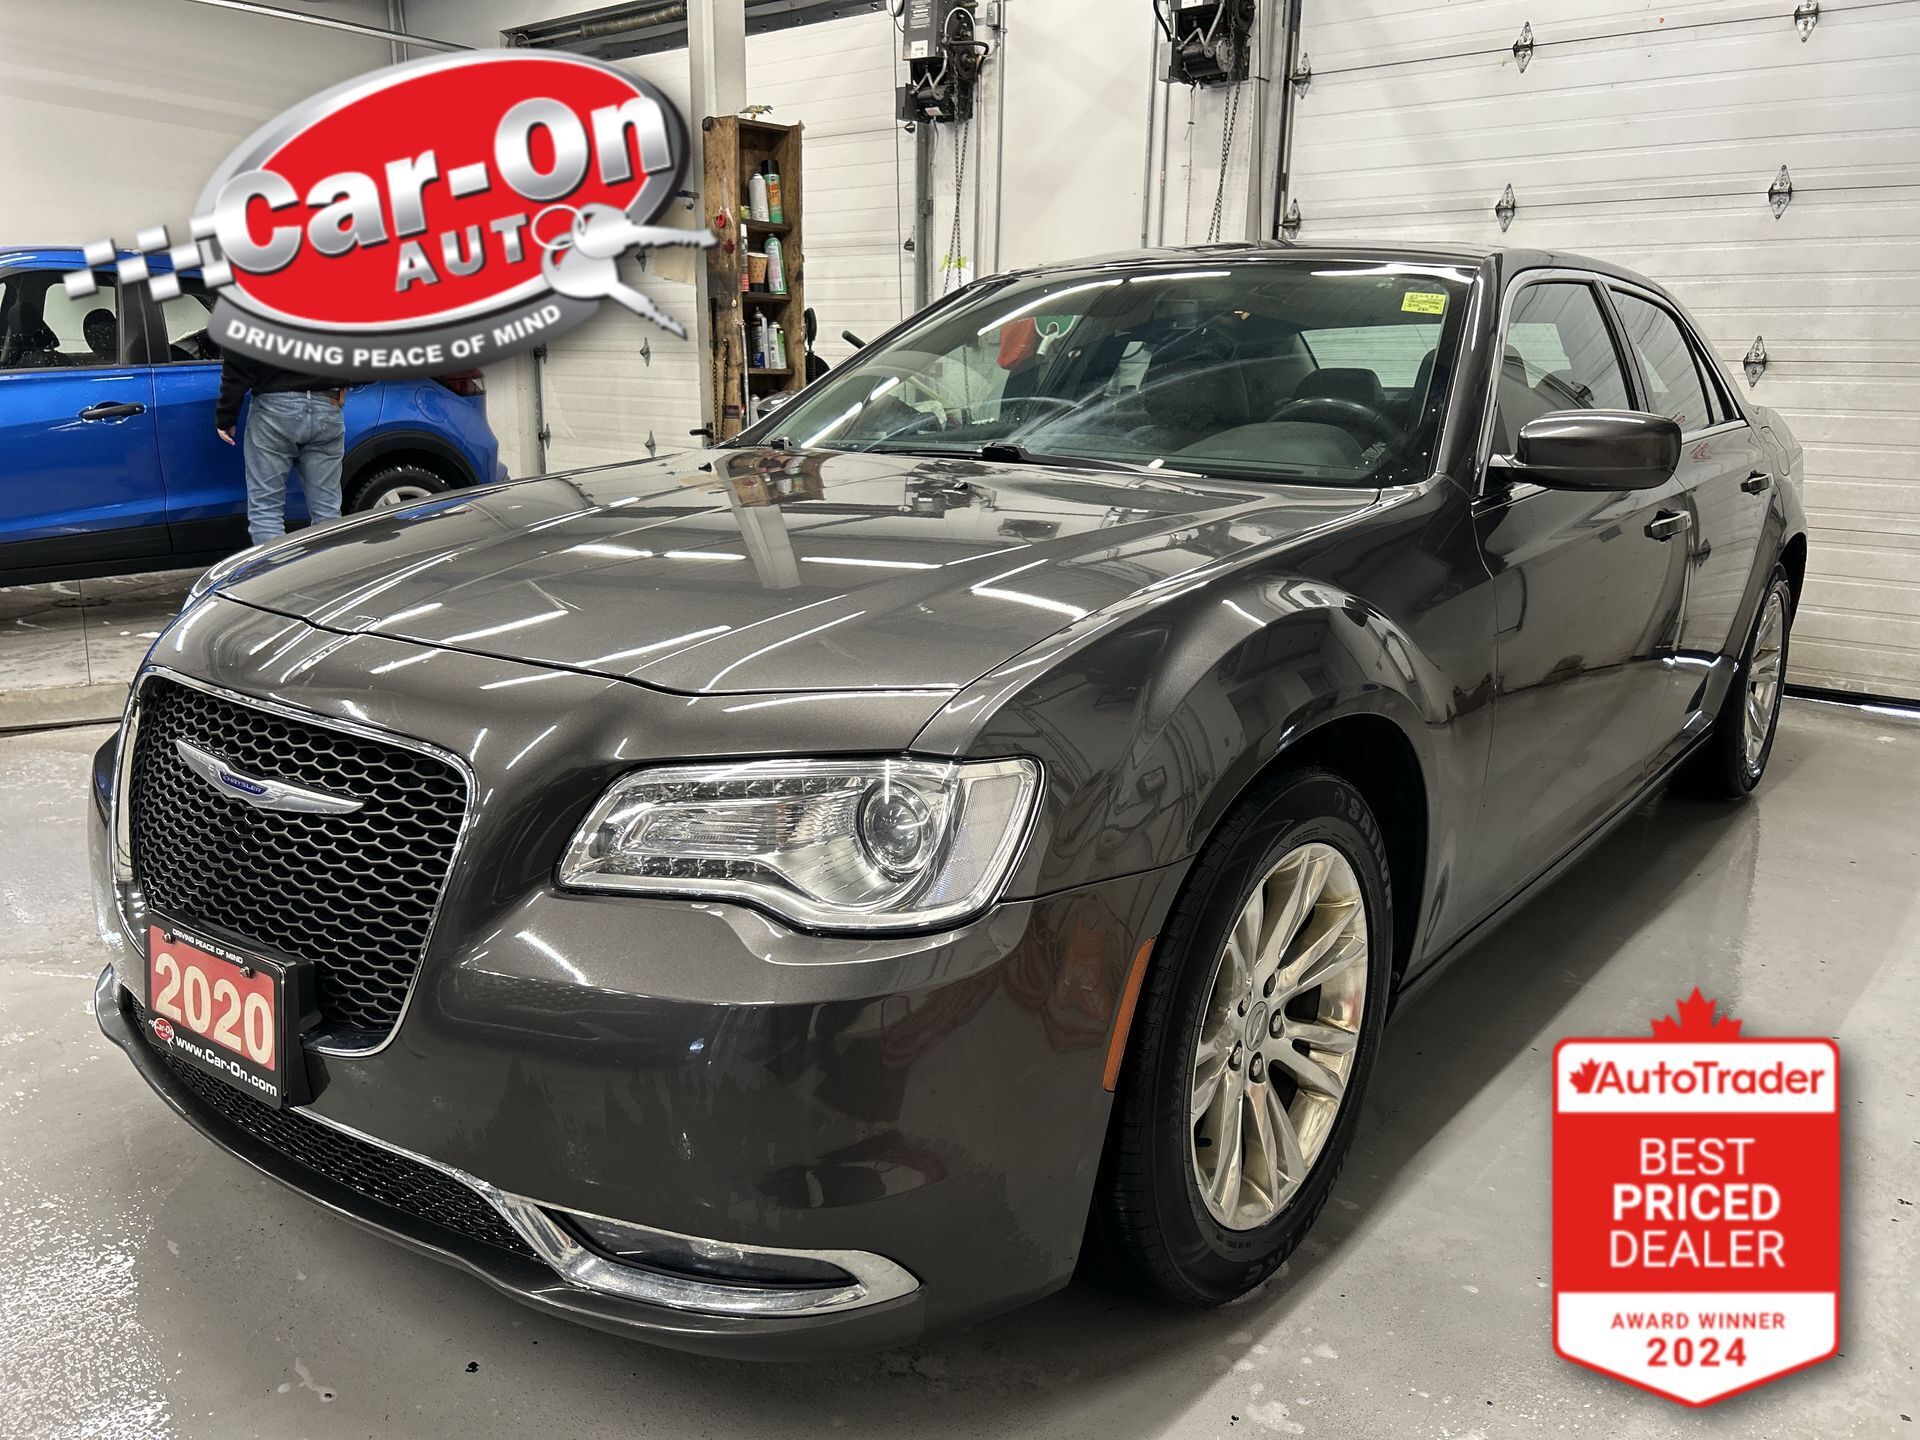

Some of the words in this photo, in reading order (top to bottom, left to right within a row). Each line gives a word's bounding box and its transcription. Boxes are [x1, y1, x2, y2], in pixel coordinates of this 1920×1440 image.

[222, 775, 262, 792] CHRYSLER
[172, 927, 195, 944] DRIVING
[195, 938, 215, 953] PEACE
[215, 947, 225, 956] OF
[225, 951, 244, 964] MIND
[155, 952, 273, 1065] 2020
[175, 1035, 278, 1097] www.Car-On.com
